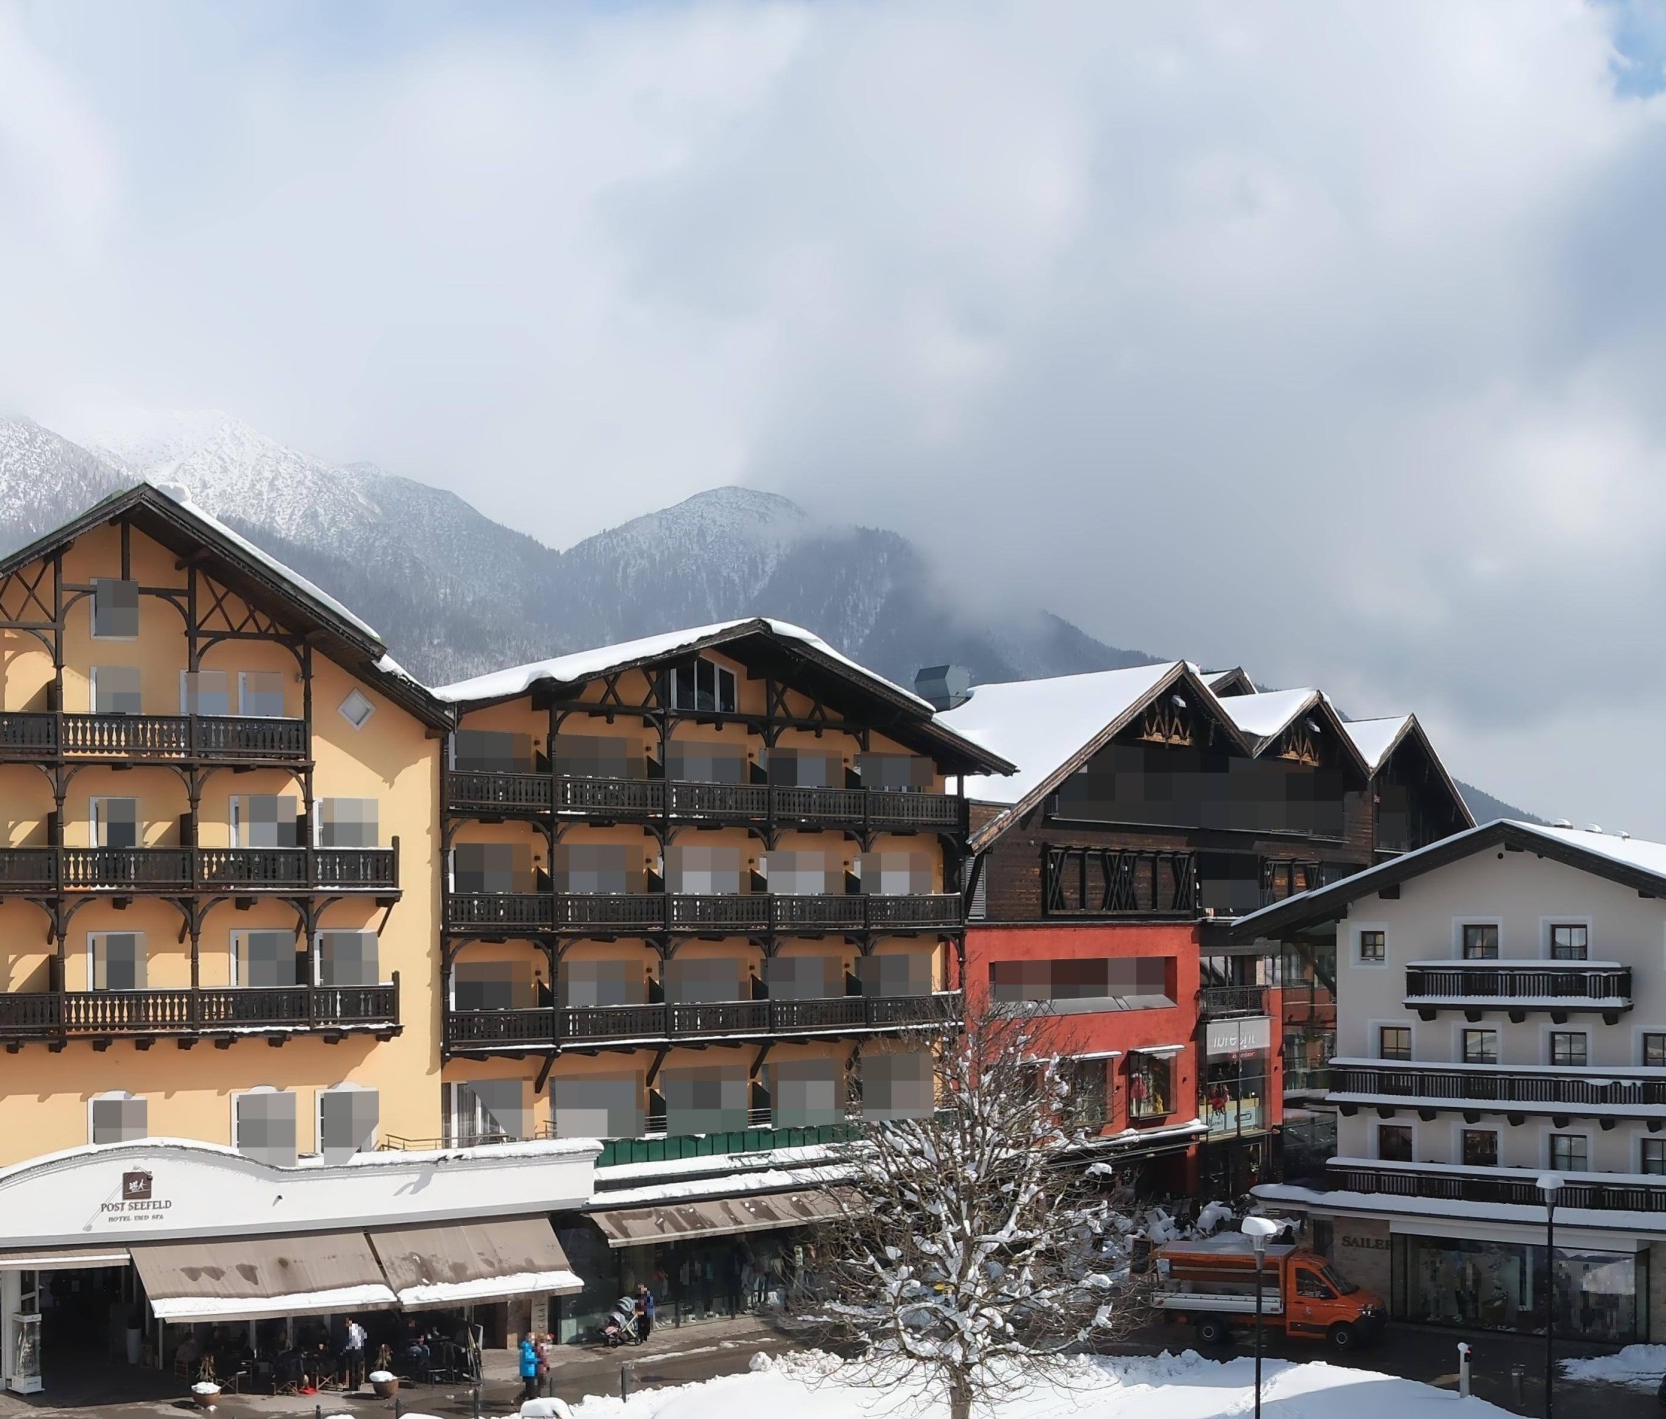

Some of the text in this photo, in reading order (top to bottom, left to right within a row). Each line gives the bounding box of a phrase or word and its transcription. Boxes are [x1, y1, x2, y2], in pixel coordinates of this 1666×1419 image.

[101, 1200, 172, 1213] POST SEEFELD
[108, 1215, 131, 1223] HOTEL
